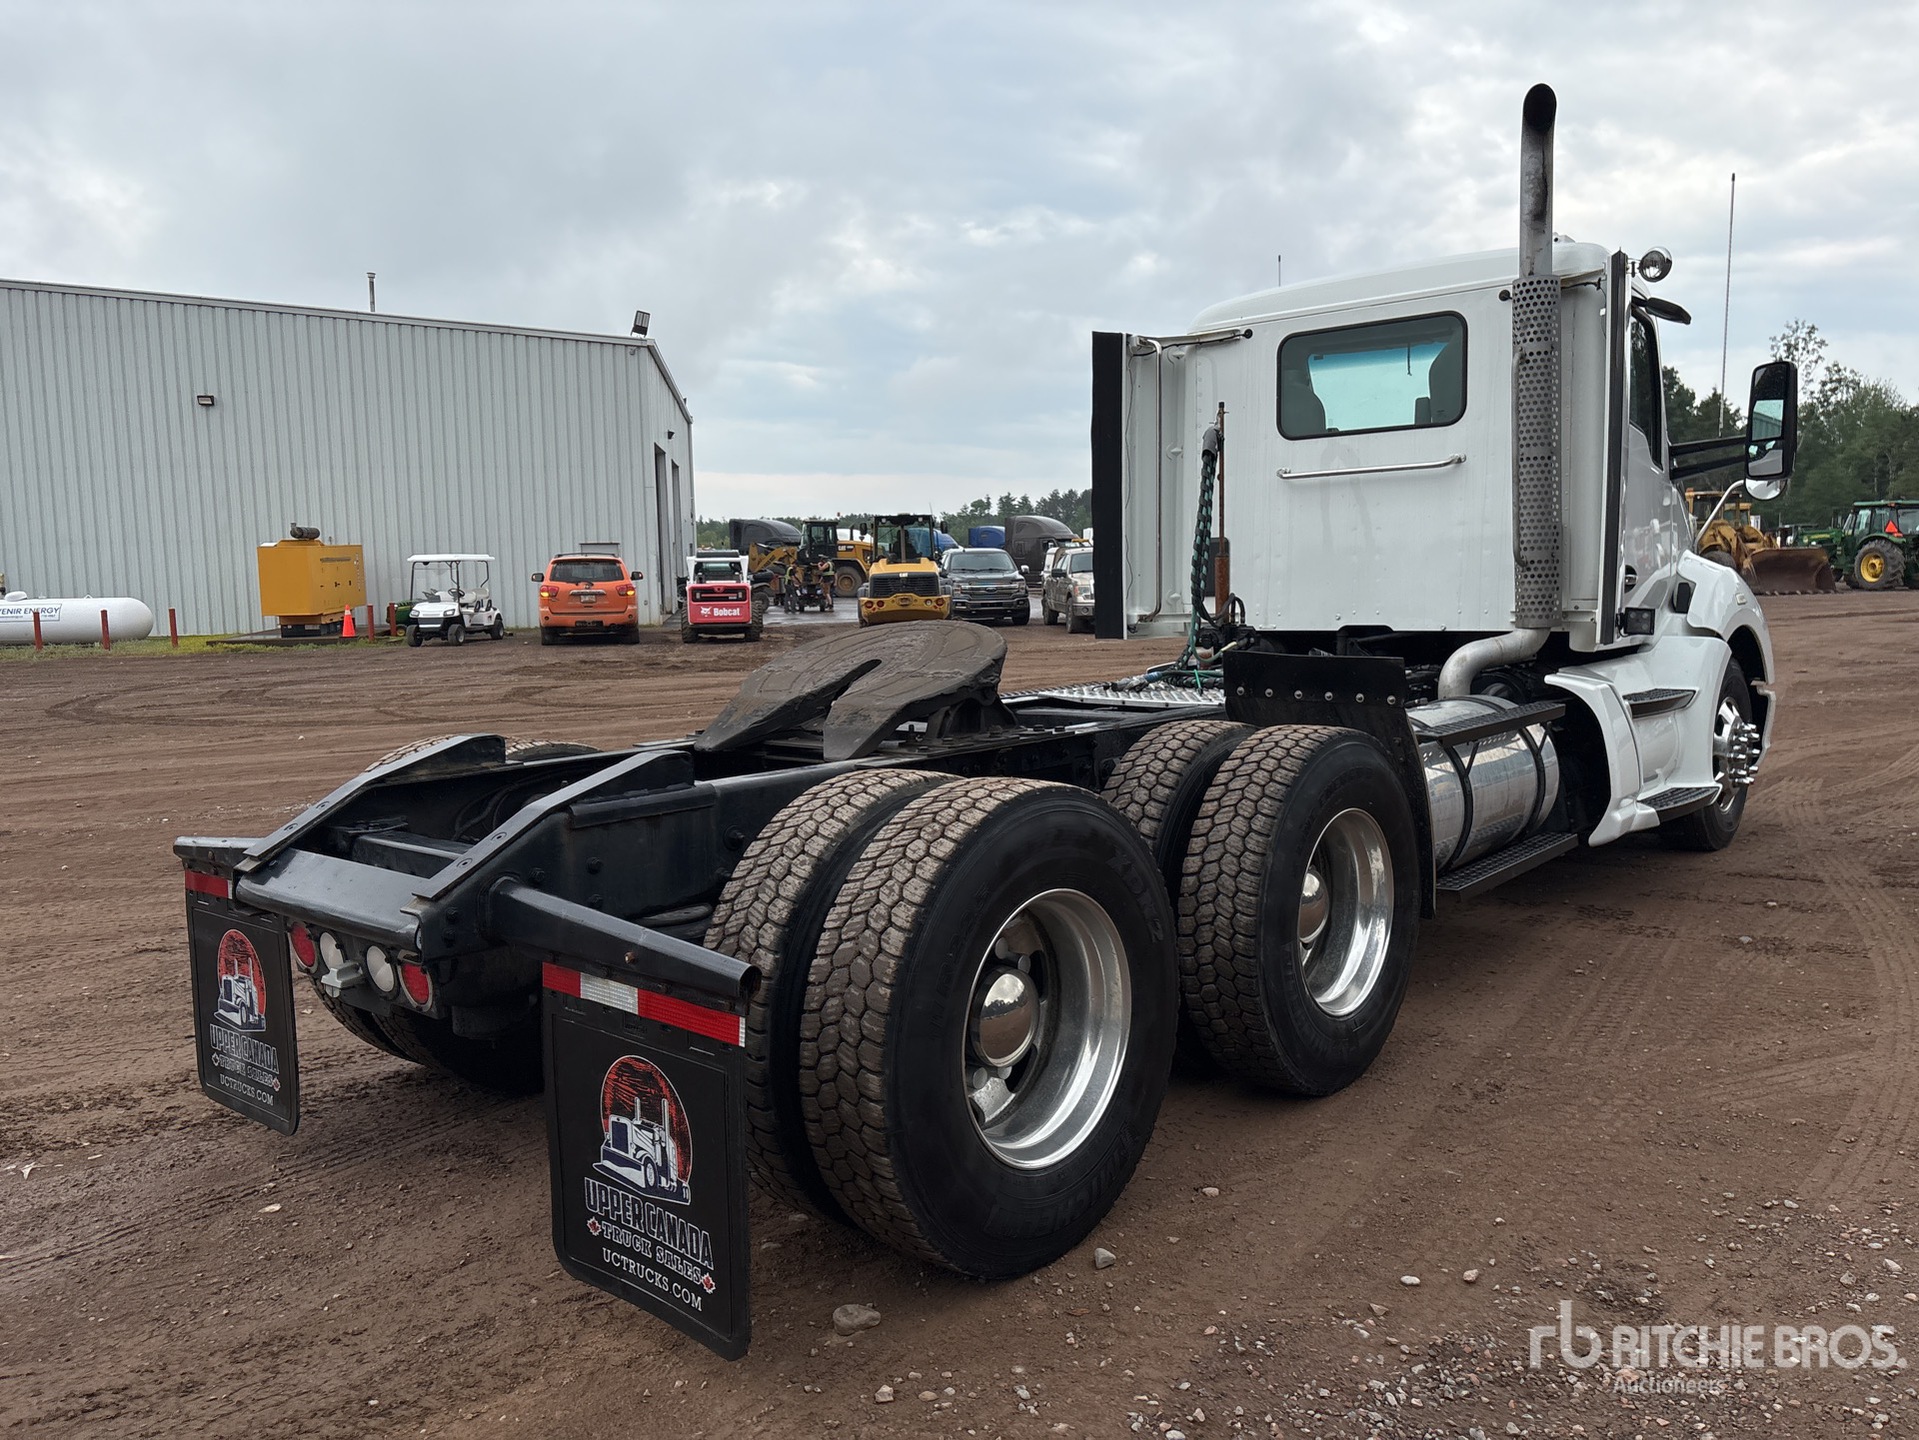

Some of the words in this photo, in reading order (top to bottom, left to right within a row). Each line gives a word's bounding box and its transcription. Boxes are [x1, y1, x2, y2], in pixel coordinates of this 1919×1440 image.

[713, 607, 740, 617] Bobcat
[209, 1023, 242, 1059] UPPER
[241, 1035, 280, 1075] CANADA
[218, 1054, 246, 1076] TRUCK
[220, 1073, 274, 1106] UCTRUCKS.COM
[584, 1177, 645, 1232] UPPER
[645, 1201, 714, 1270] CANADA
[601, 1220, 652, 1258] TRUCK
[656, 1246, 702, 1285] SALES
[602, 1247, 703, 1312] UCTRUCKS.COM
